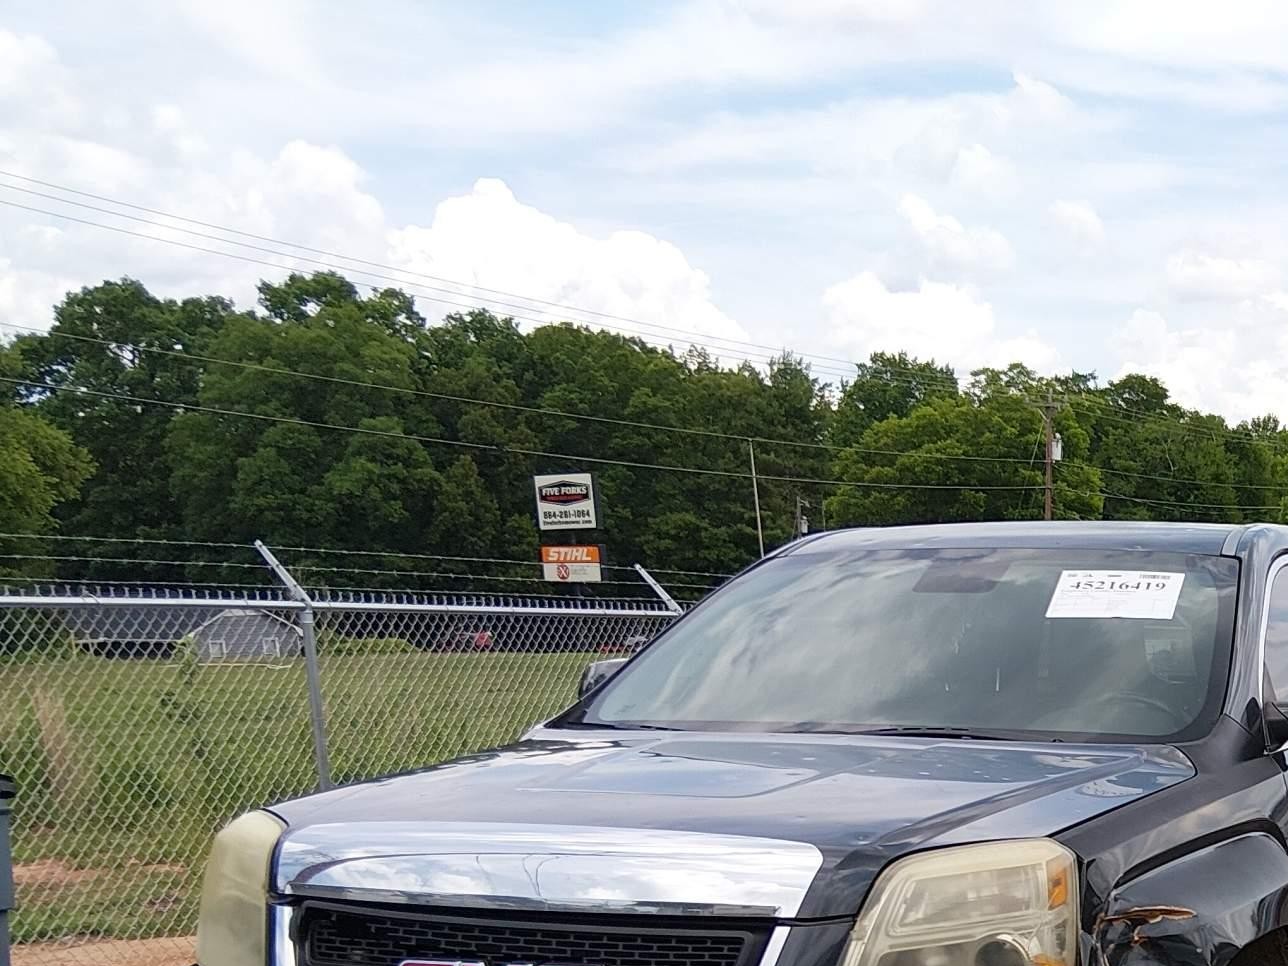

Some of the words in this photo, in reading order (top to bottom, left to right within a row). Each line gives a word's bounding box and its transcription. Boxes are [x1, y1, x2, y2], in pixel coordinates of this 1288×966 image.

[542, 487, 560, 497] FIVE
[560, 486, 587, 496] FORKS
[548, 547, 592, 560] STIHL
[1070, 580, 1167, 591] 45216419
